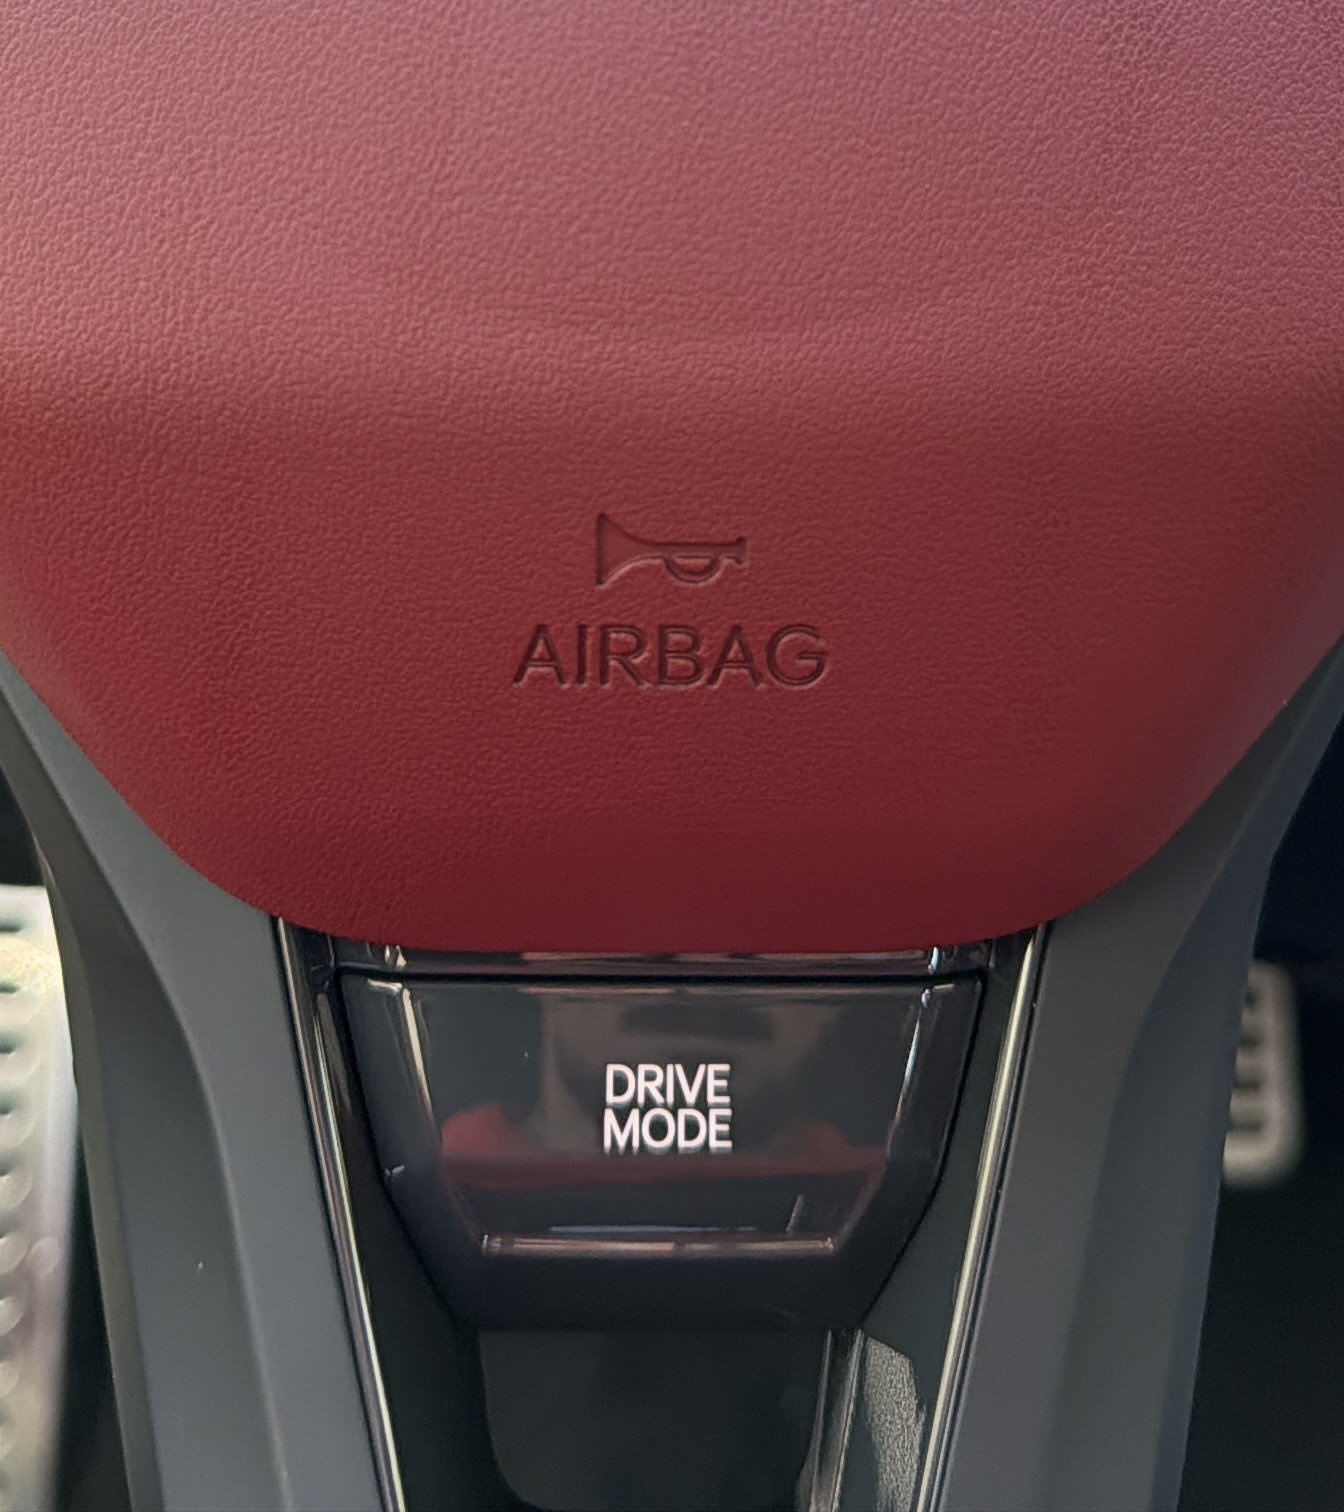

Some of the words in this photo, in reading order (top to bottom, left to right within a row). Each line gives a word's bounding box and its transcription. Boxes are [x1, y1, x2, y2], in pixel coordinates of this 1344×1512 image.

[513, 622, 830, 688] AIRBAG
[606, 1063, 732, 1107] DRIVE
[603, 1107, 733, 1155] MODE
